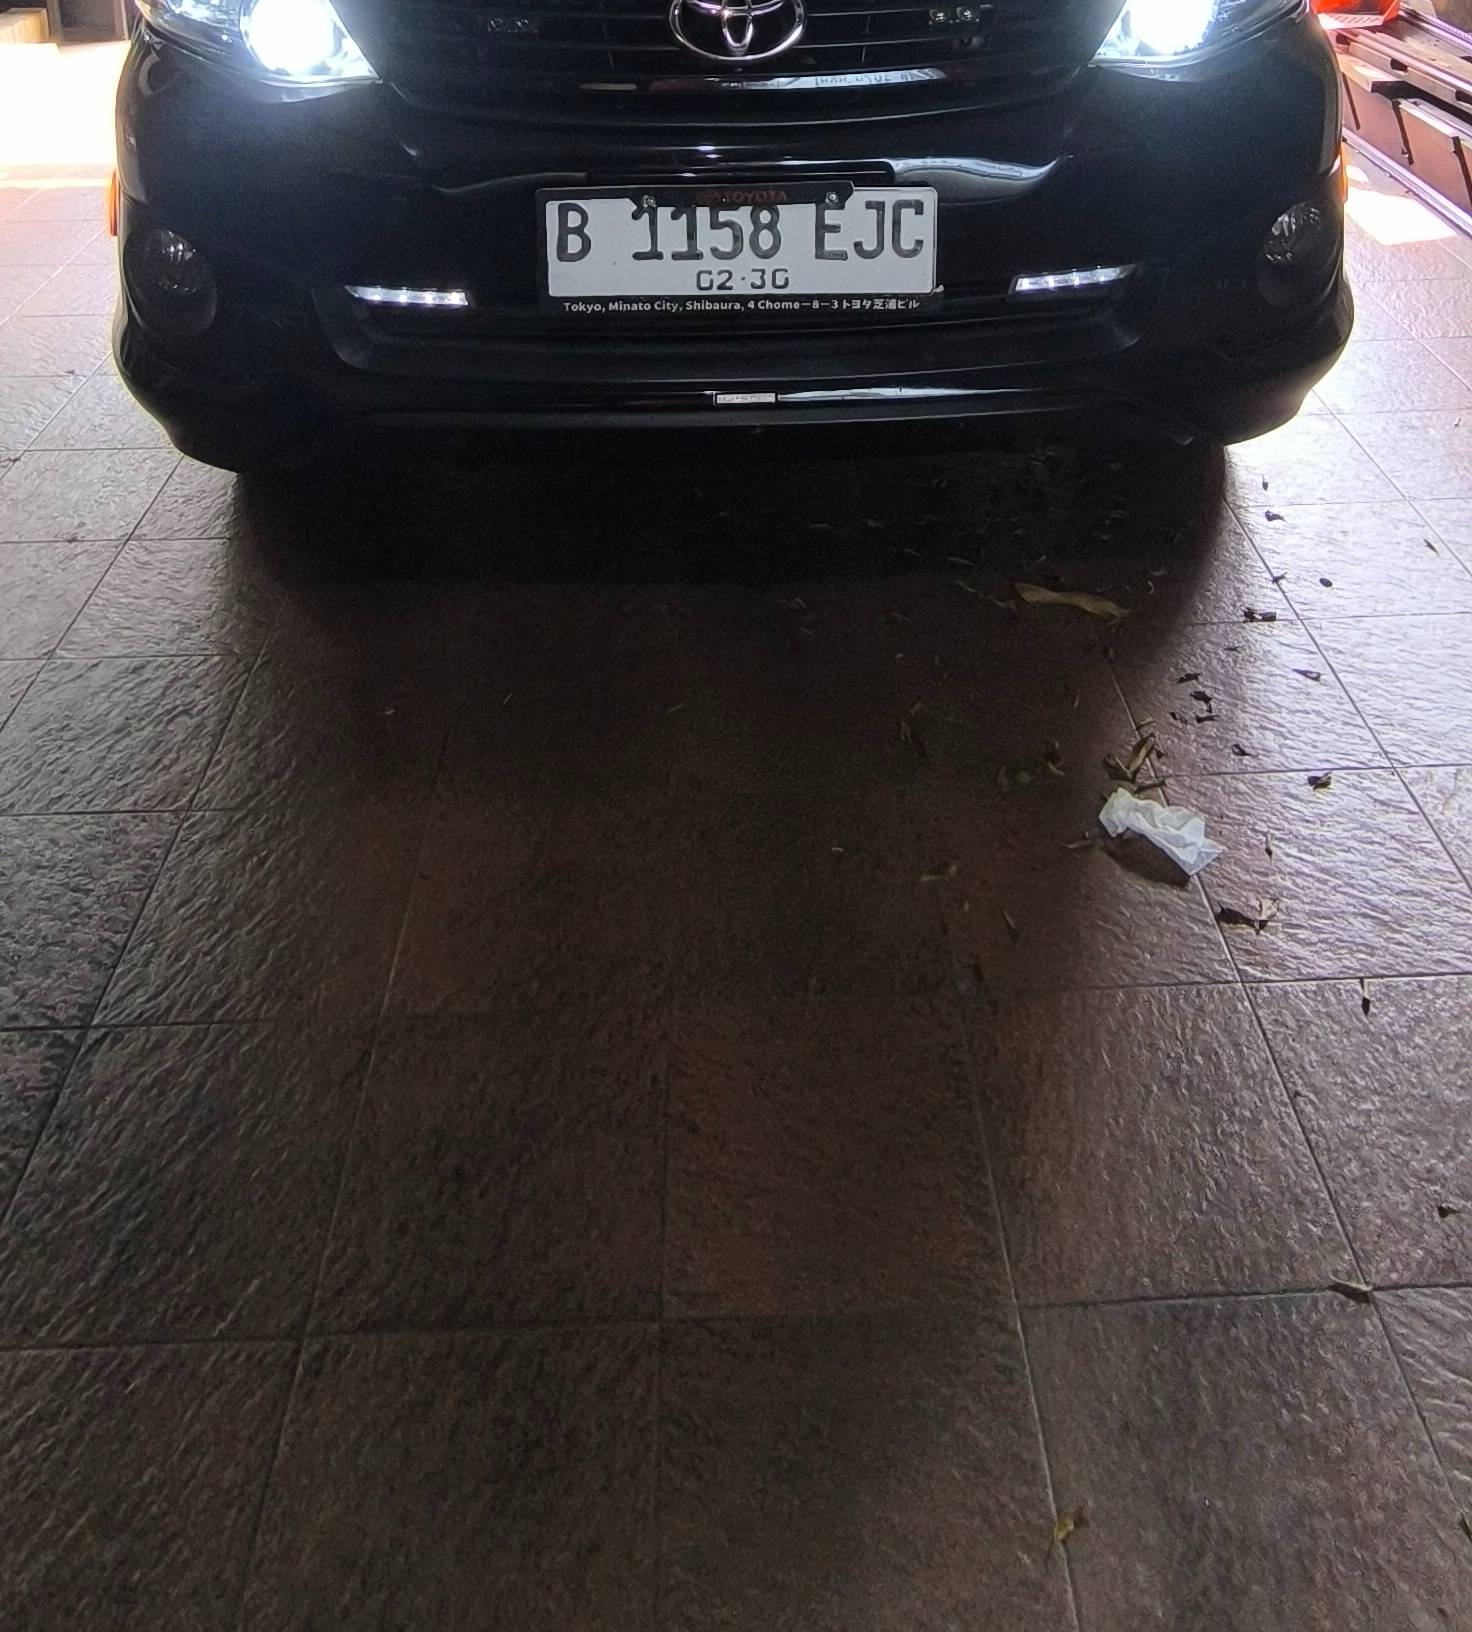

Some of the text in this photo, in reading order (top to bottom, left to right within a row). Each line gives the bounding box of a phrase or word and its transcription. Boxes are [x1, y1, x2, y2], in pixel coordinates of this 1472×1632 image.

[721, 191, 788, 202] TOYOTA
[557, 200, 924, 262] B 1158 EJC
[564, 301, 606, 314] Tokyo,
[608, 301, 651, 312] Minato
[654, 300, 683, 313] City,
[685, 299, 745, 312] Shibaura,
[747, 300, 755, 310] 4
